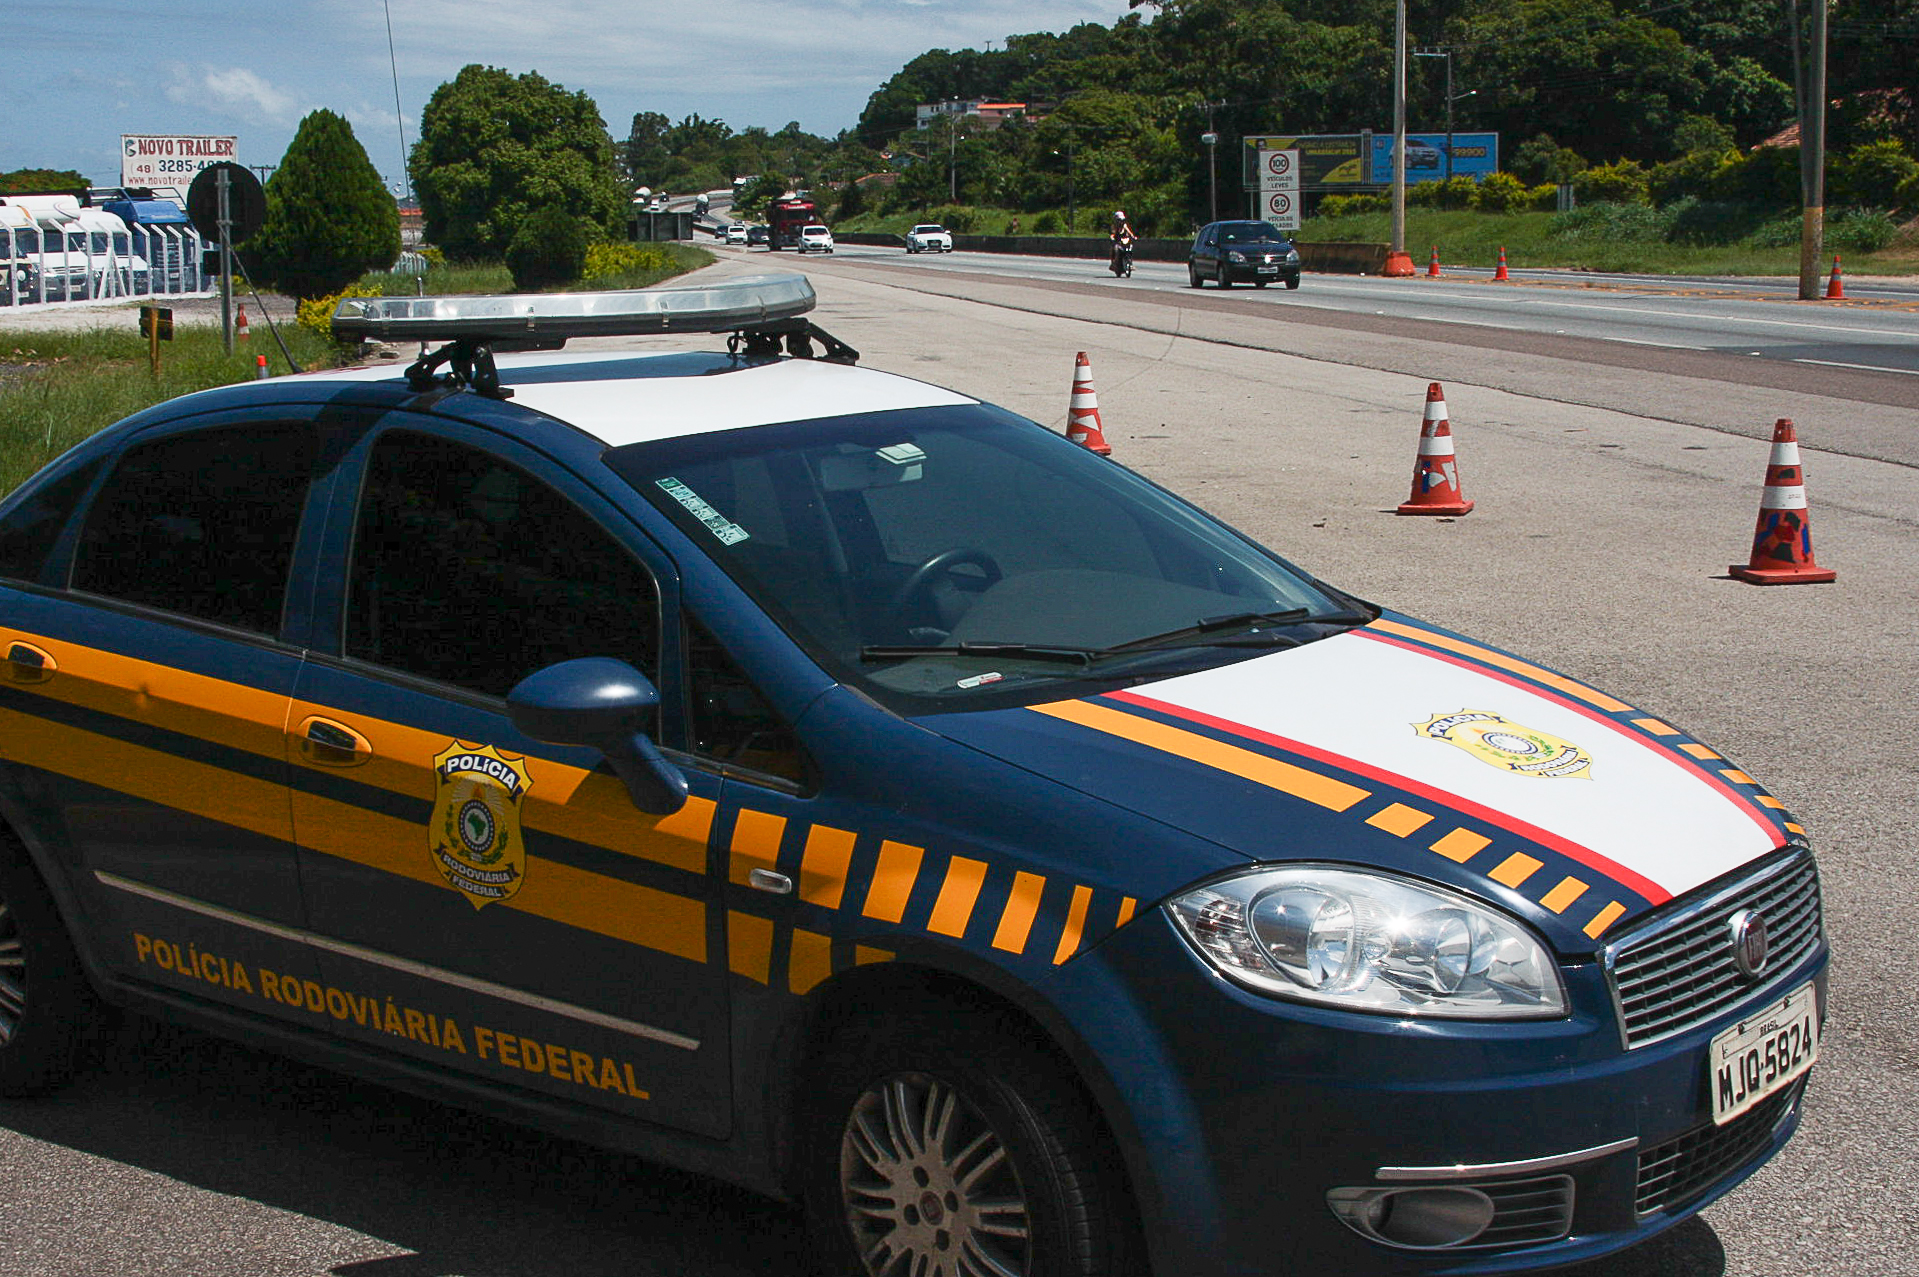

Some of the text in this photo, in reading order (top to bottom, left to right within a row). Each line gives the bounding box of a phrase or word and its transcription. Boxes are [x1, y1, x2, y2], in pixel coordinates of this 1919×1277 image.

[138, 139, 234, 157] NOVO TRAILER
[1272, 159, 1287, 167] 100
[127, 175, 193, 186] www.novotraile
[1273, 199, 1287, 208] 80
[446, 755, 517, 790] POLÍCIA
[443, 854, 511, 883] RODOVIÁRIA
[452, 876, 501, 896] FEDERAL
[133, 932, 650, 1101] POLÍCIA RODOVIÁRIA FEDERAL
